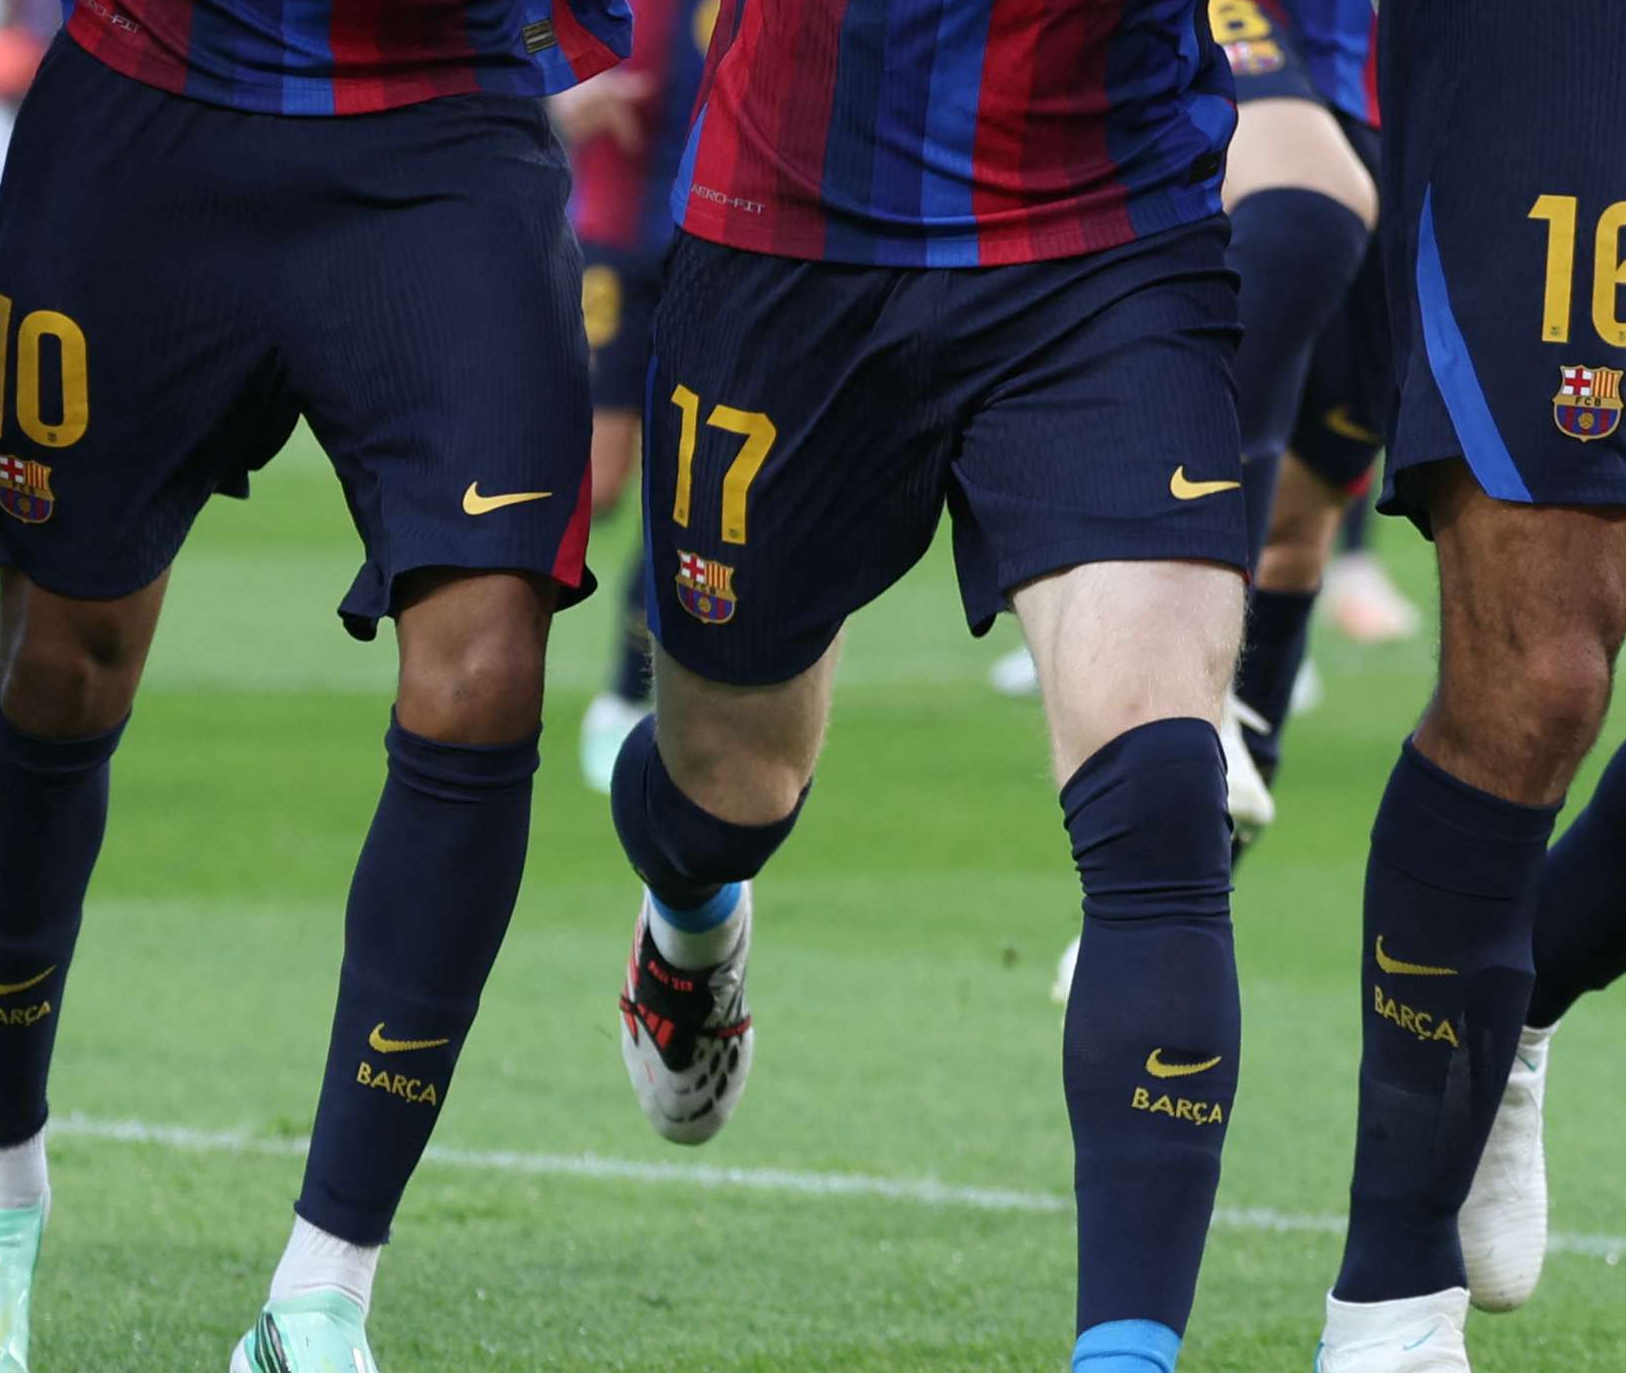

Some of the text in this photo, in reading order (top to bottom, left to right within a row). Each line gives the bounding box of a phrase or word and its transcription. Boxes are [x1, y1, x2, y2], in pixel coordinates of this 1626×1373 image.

[690, 183, 766, 215] AERO-FIT
[670, 383, 777, 546] 17
[1374, 984, 1460, 1048] BARÇA
[356, 1061, 438, 1106] BARÇA
[1131, 1087, 1223, 1125] BARÇA
